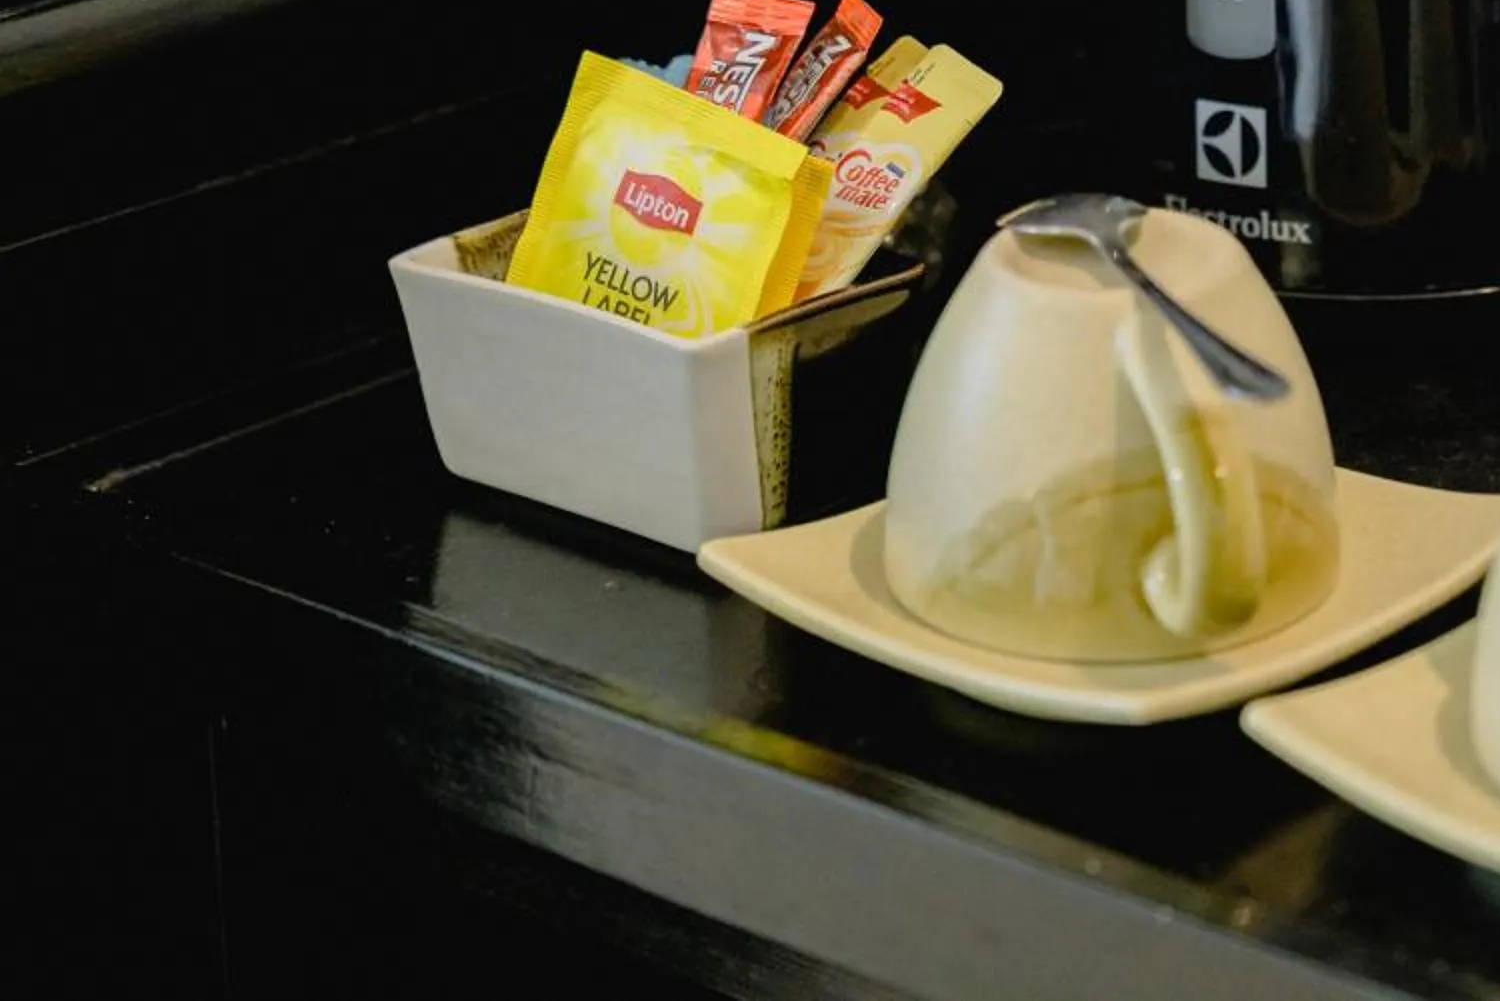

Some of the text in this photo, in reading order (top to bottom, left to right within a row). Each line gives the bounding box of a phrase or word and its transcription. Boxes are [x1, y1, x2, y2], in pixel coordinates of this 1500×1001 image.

[713, 31, 777, 114] NES
[835, 150, 899, 193] Coffee
[623, 180, 690, 229] Lipton
[835, 185, 889, 209] mate
[584, 251, 679, 312] YELLOW
